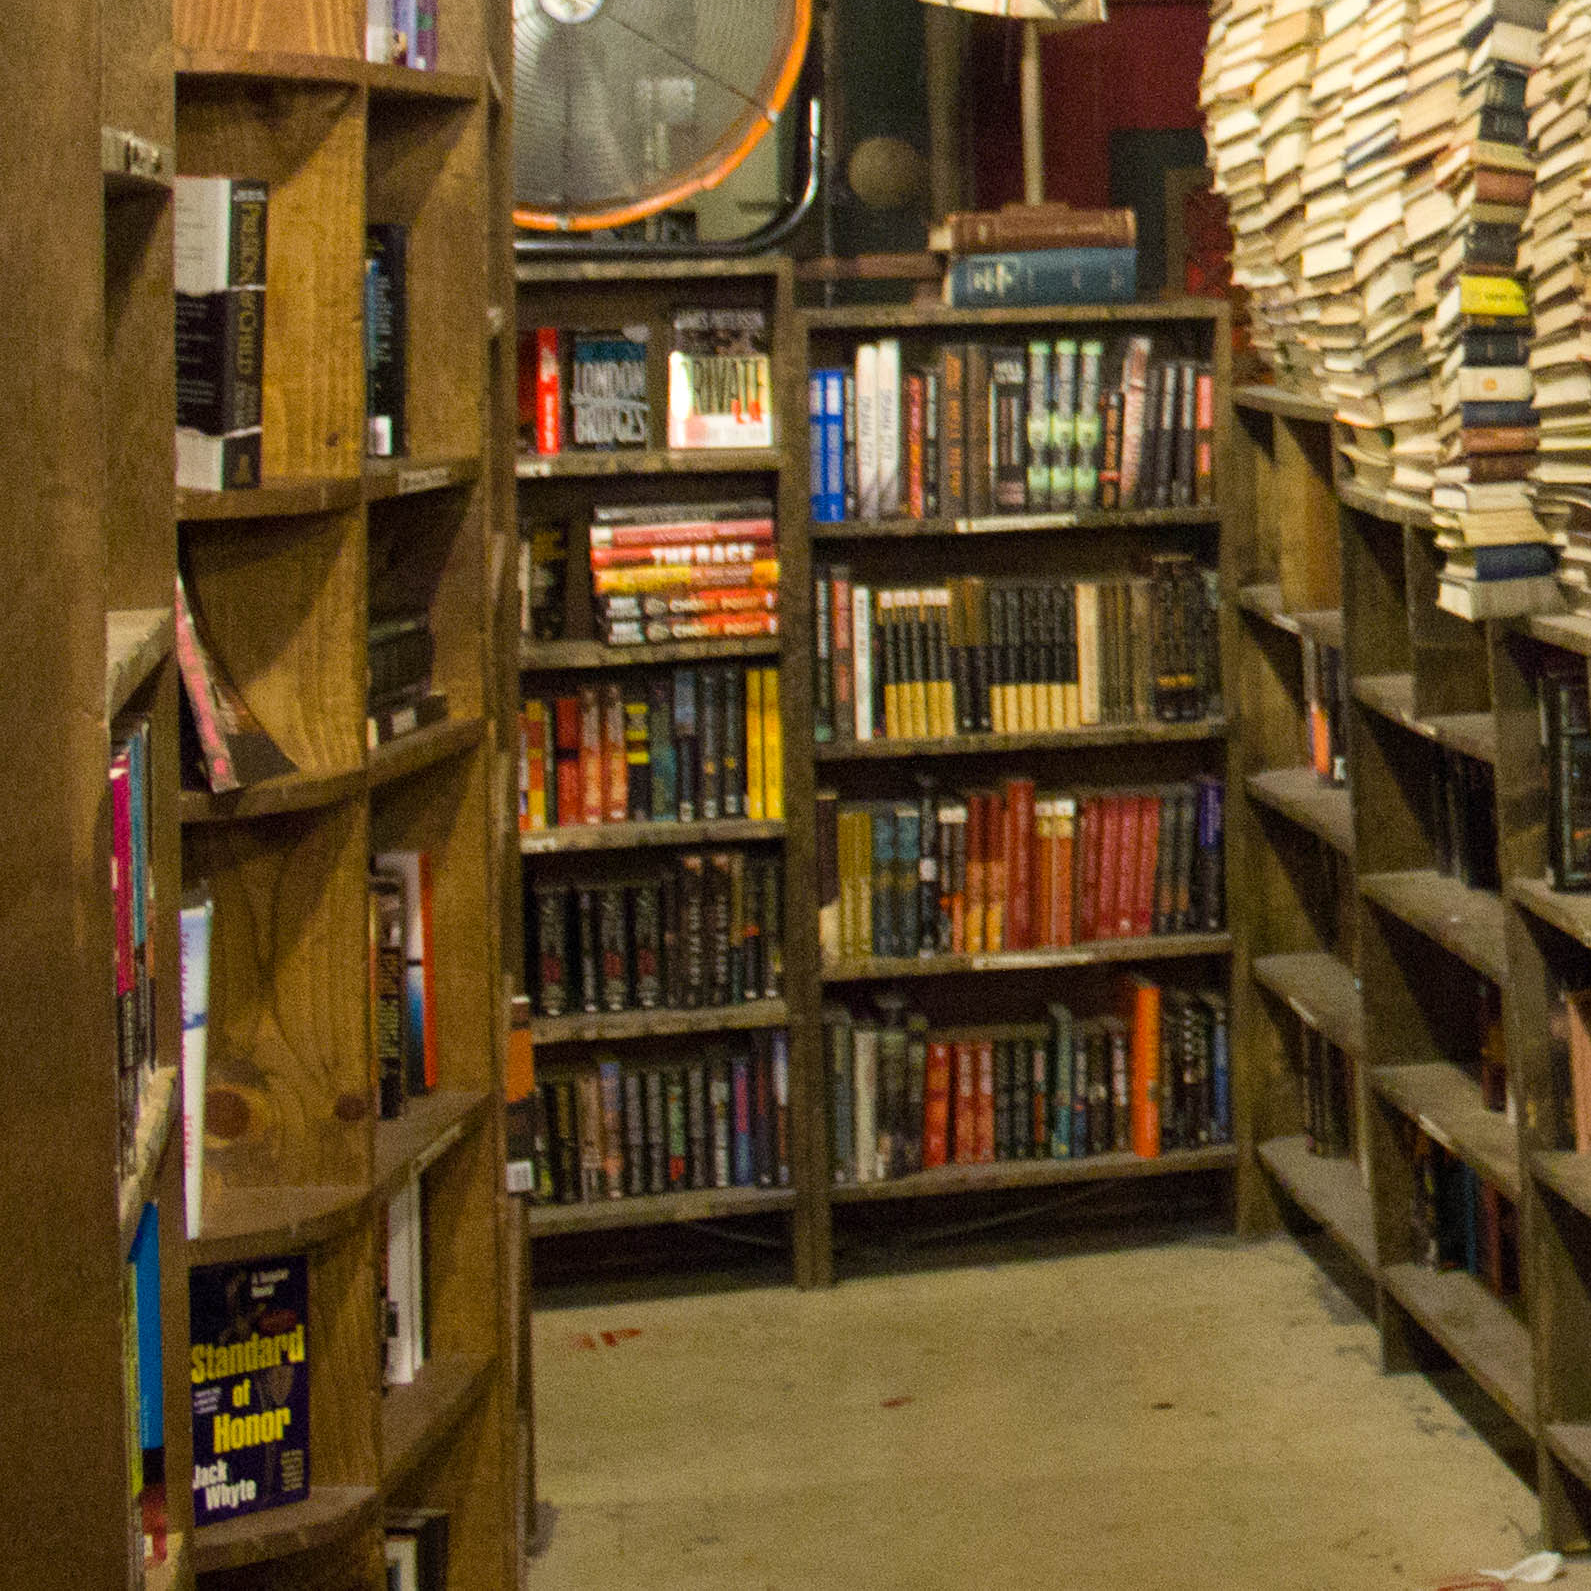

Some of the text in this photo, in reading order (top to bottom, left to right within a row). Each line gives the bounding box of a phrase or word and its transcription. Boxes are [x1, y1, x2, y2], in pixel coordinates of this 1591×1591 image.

[190, 1323, 306, 1385] Standard
[231, 1378, 252, 1408] of
[212, 1406, 292, 1454] Honor
[191, 1457, 230, 1490] Jack
[204, 1478, 258, 1512] Whyte
